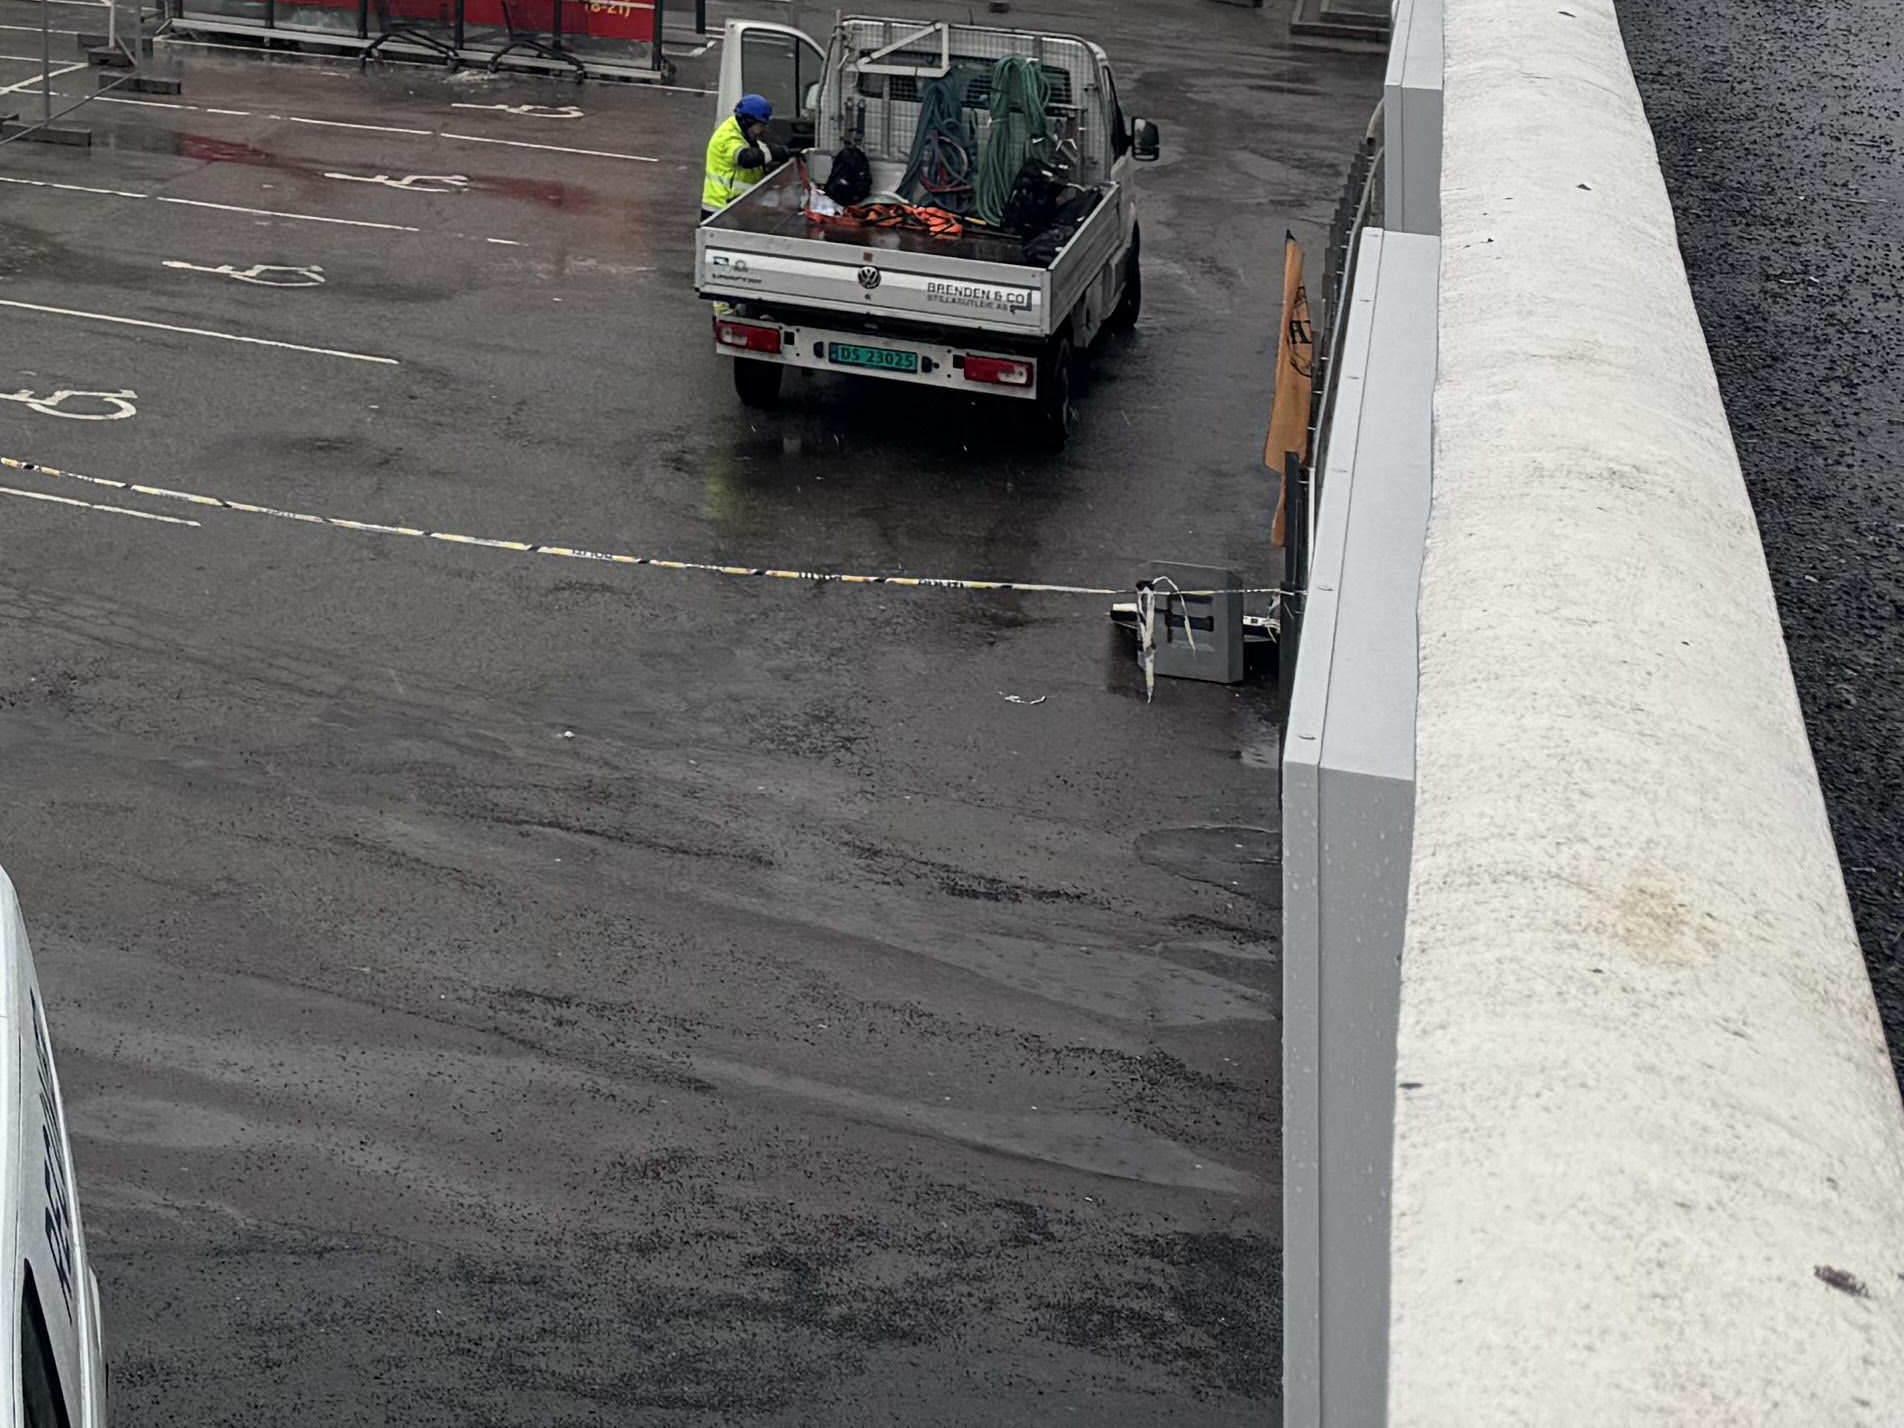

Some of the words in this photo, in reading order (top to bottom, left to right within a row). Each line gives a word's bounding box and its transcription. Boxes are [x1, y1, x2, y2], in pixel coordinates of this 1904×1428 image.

[927, 282, 991, 300] BRENDEN
[994, 291, 1003, 301] &
[1006, 293, 1025, 304] CO
[841, 347, 860, 361] DS
[867, 350, 914, 367] 23025
